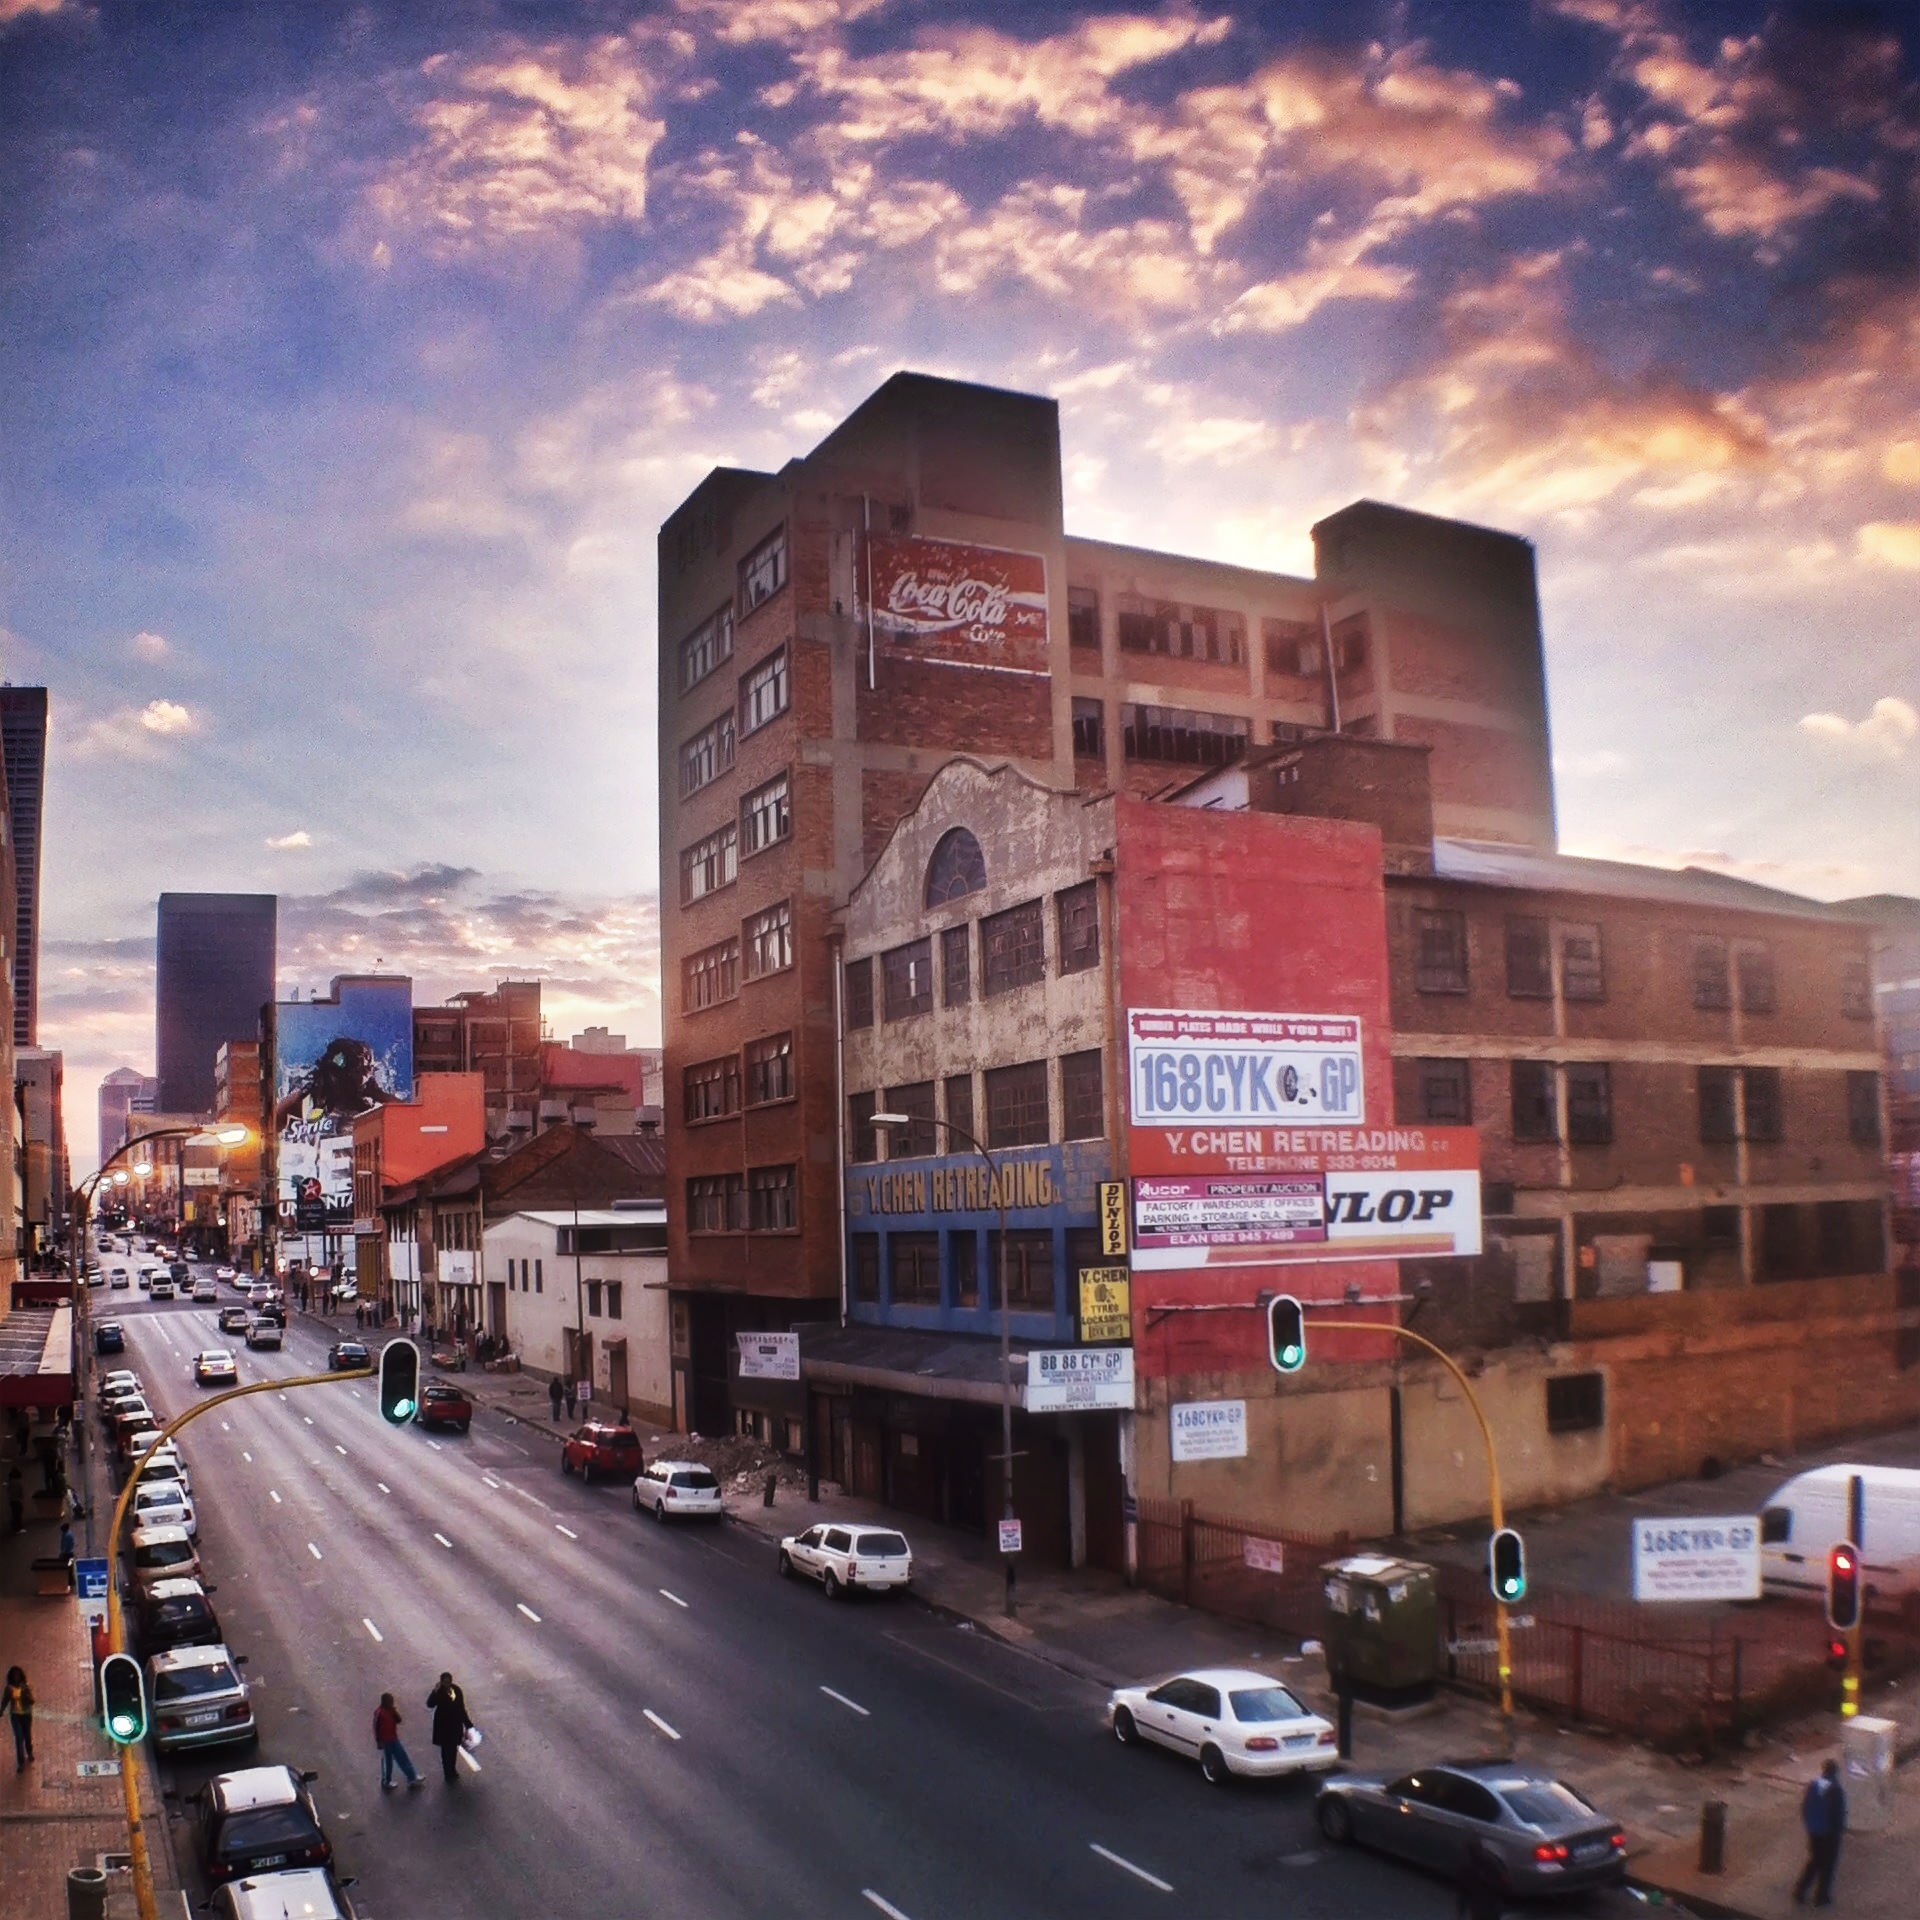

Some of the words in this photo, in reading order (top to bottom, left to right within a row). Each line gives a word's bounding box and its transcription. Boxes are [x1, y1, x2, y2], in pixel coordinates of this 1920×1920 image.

[1178, 1021, 1212, 1033] PLATES
[1215, 1022, 1248, 1034] MADE
[1251, 1023, 1283, 1035] WHILE
[1287, 1024, 1318, 1036] YOU
[1140, 1053, 1277, 1112] 168CYK
[1320, 1057, 1357, 1112] GP
[288, 1119, 333, 1140] Sprite
[1273, 1130, 1426, 1152] RETREADING
[1226, 1156, 1320, 1171] TELEPHONE
[931, 1160, 1052, 1213] RETREADING
[1138, 1181, 1191, 1198] Aucor
[1210, 1184, 1268, 1195] PROPERTY
[1270, 1183, 1317, 1194] AUCTION
[1146, 1201, 1193, 1212] FACTORY
[1202, 1200, 1265, 1210] WAREHOUSE
[1274, 1198, 1315, 1208] OFFICES
[1106, 1185, 1121, 1252] DUNLOP
[1143, 1213, 1190, 1224] PARKING
[1201, 1211, 1249, 1222] STORAGE
[1170, 1233, 1208, 1244] ELAN
[1062, 1355, 1077, 1369] 88
[1106, 1353, 1120, 1368] GP
